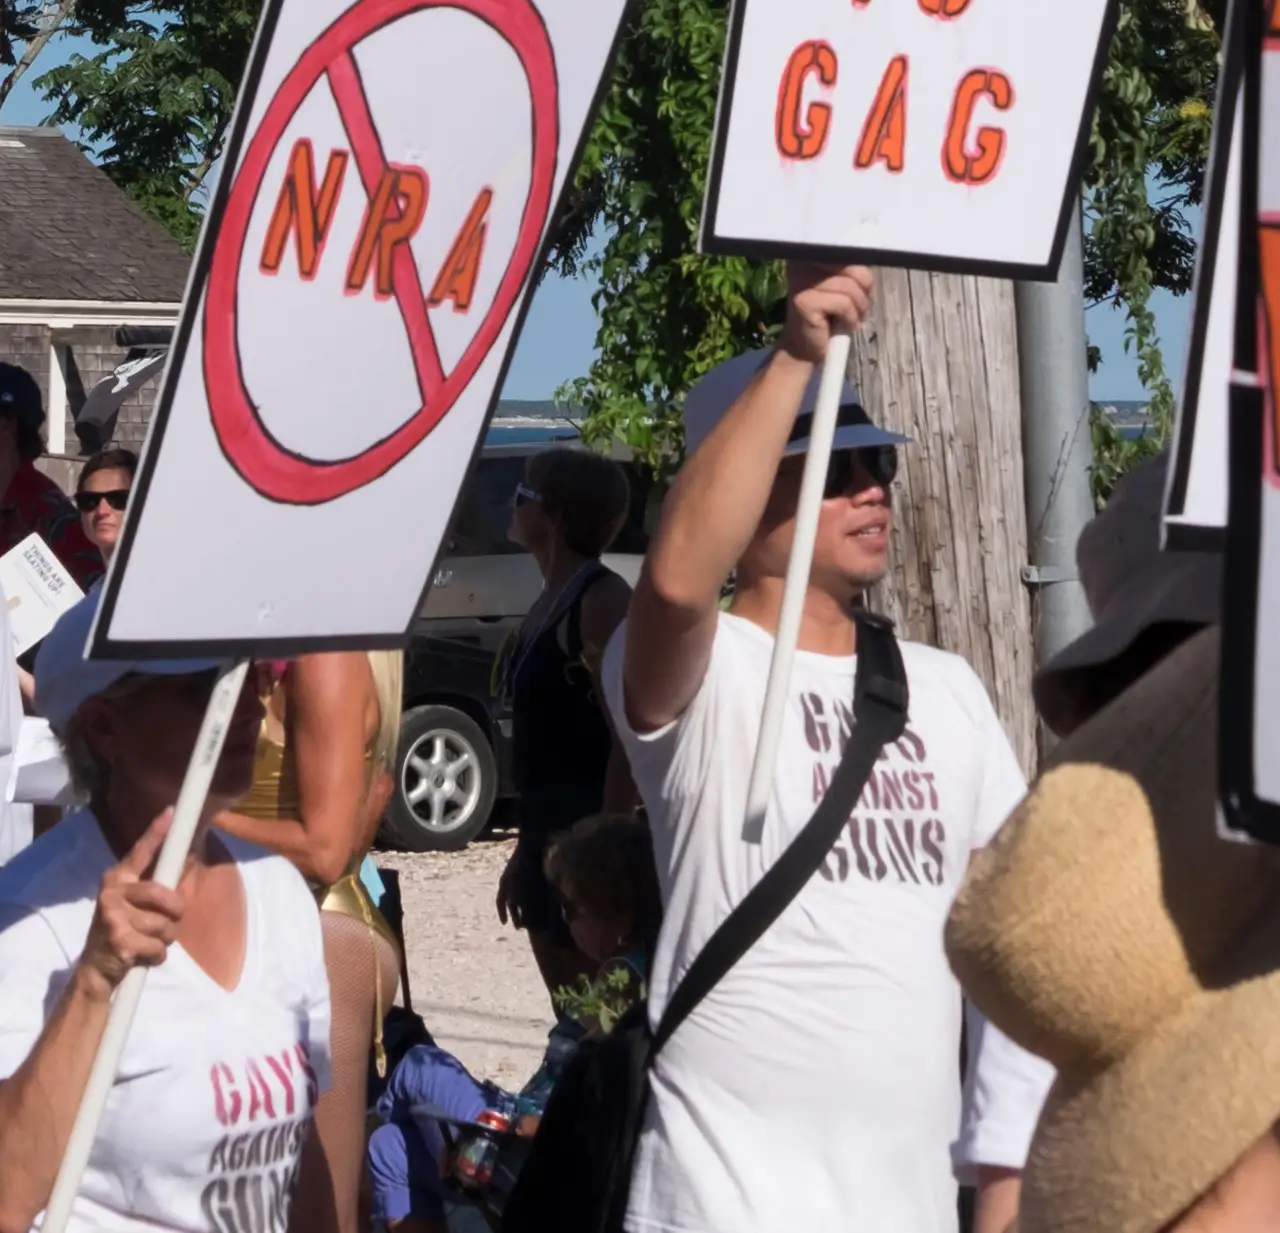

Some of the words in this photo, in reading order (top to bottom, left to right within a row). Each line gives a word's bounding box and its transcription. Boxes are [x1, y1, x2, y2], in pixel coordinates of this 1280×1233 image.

[774, 38, 1015, 186] GAG
[260, 138, 493, 313] NRA
[812, 763, 938, 811] AINST
[210, 1041, 318, 1127] GAYS
[207, 1121, 304, 1173] AGAINS
[200, 1166, 295, 1233] GUN
